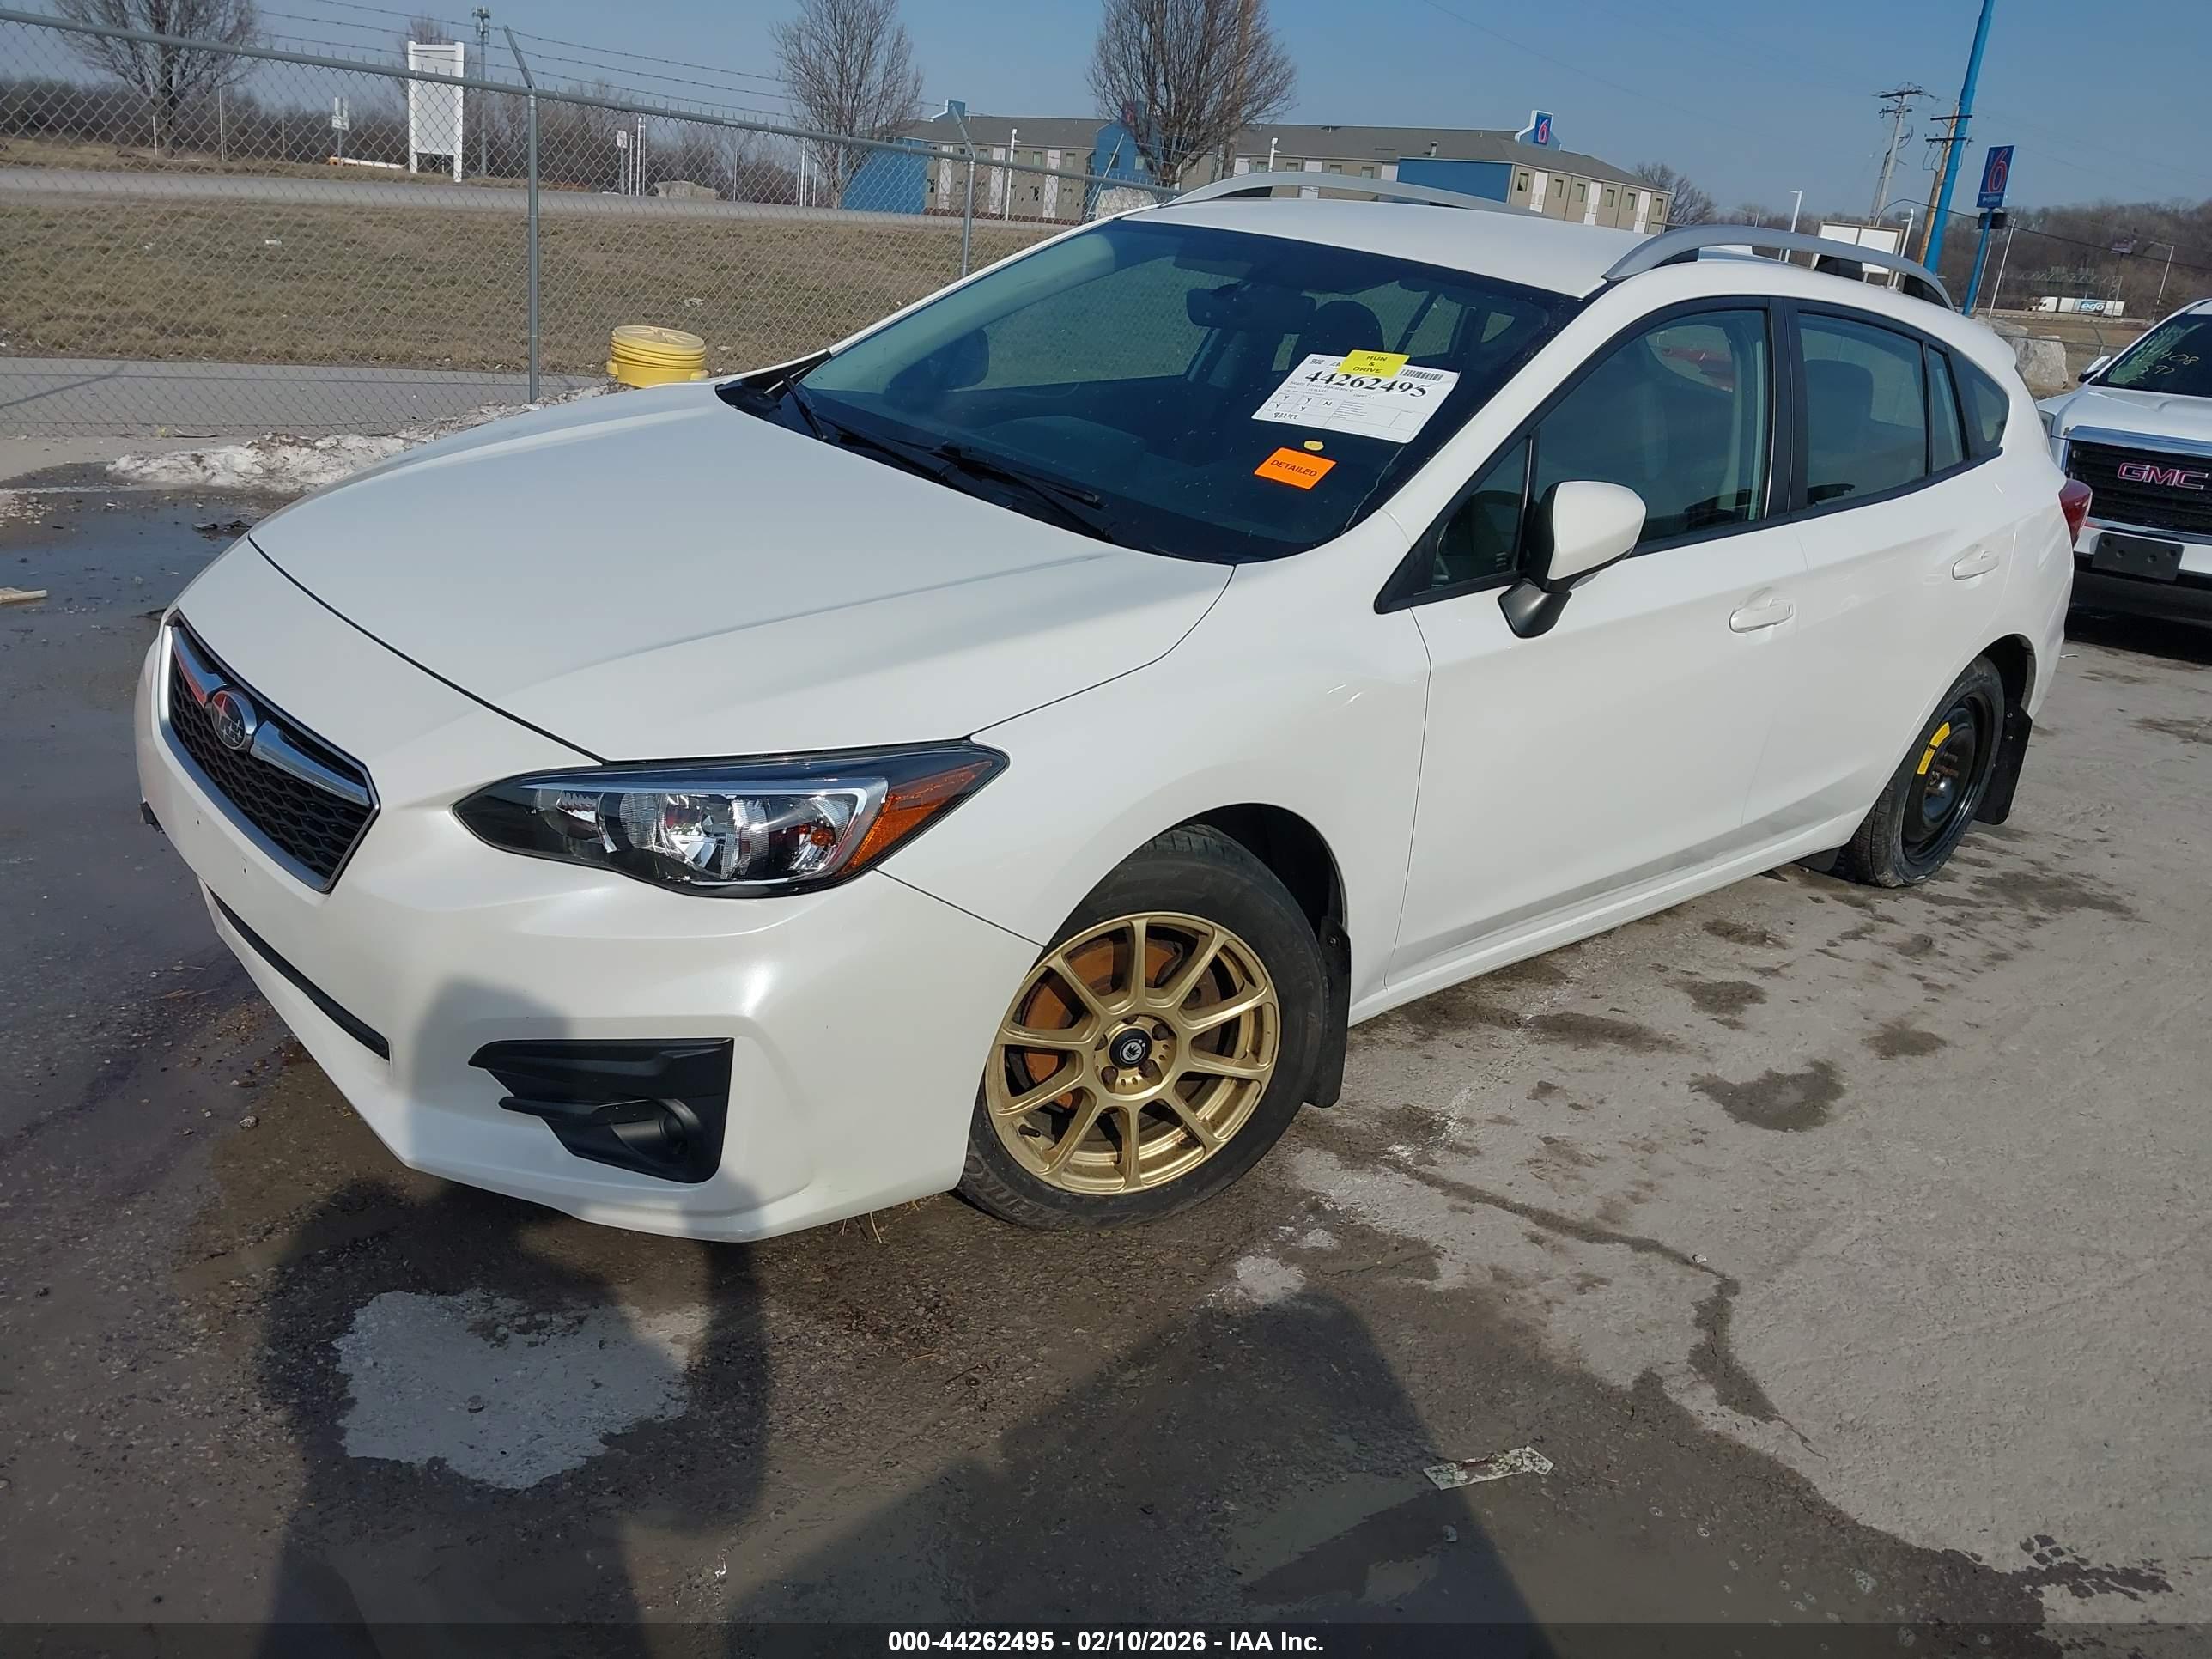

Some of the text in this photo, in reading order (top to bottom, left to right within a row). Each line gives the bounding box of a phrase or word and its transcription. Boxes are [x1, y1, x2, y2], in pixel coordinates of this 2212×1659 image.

[1538, 118, 1549, 143] 6
[1988, 148, 2009, 192] 6
[1304, 370, 1431, 398] 44262495
[1270, 459, 1317, 477] DETAILED
[2117, 462, 2209, 490] GMC
